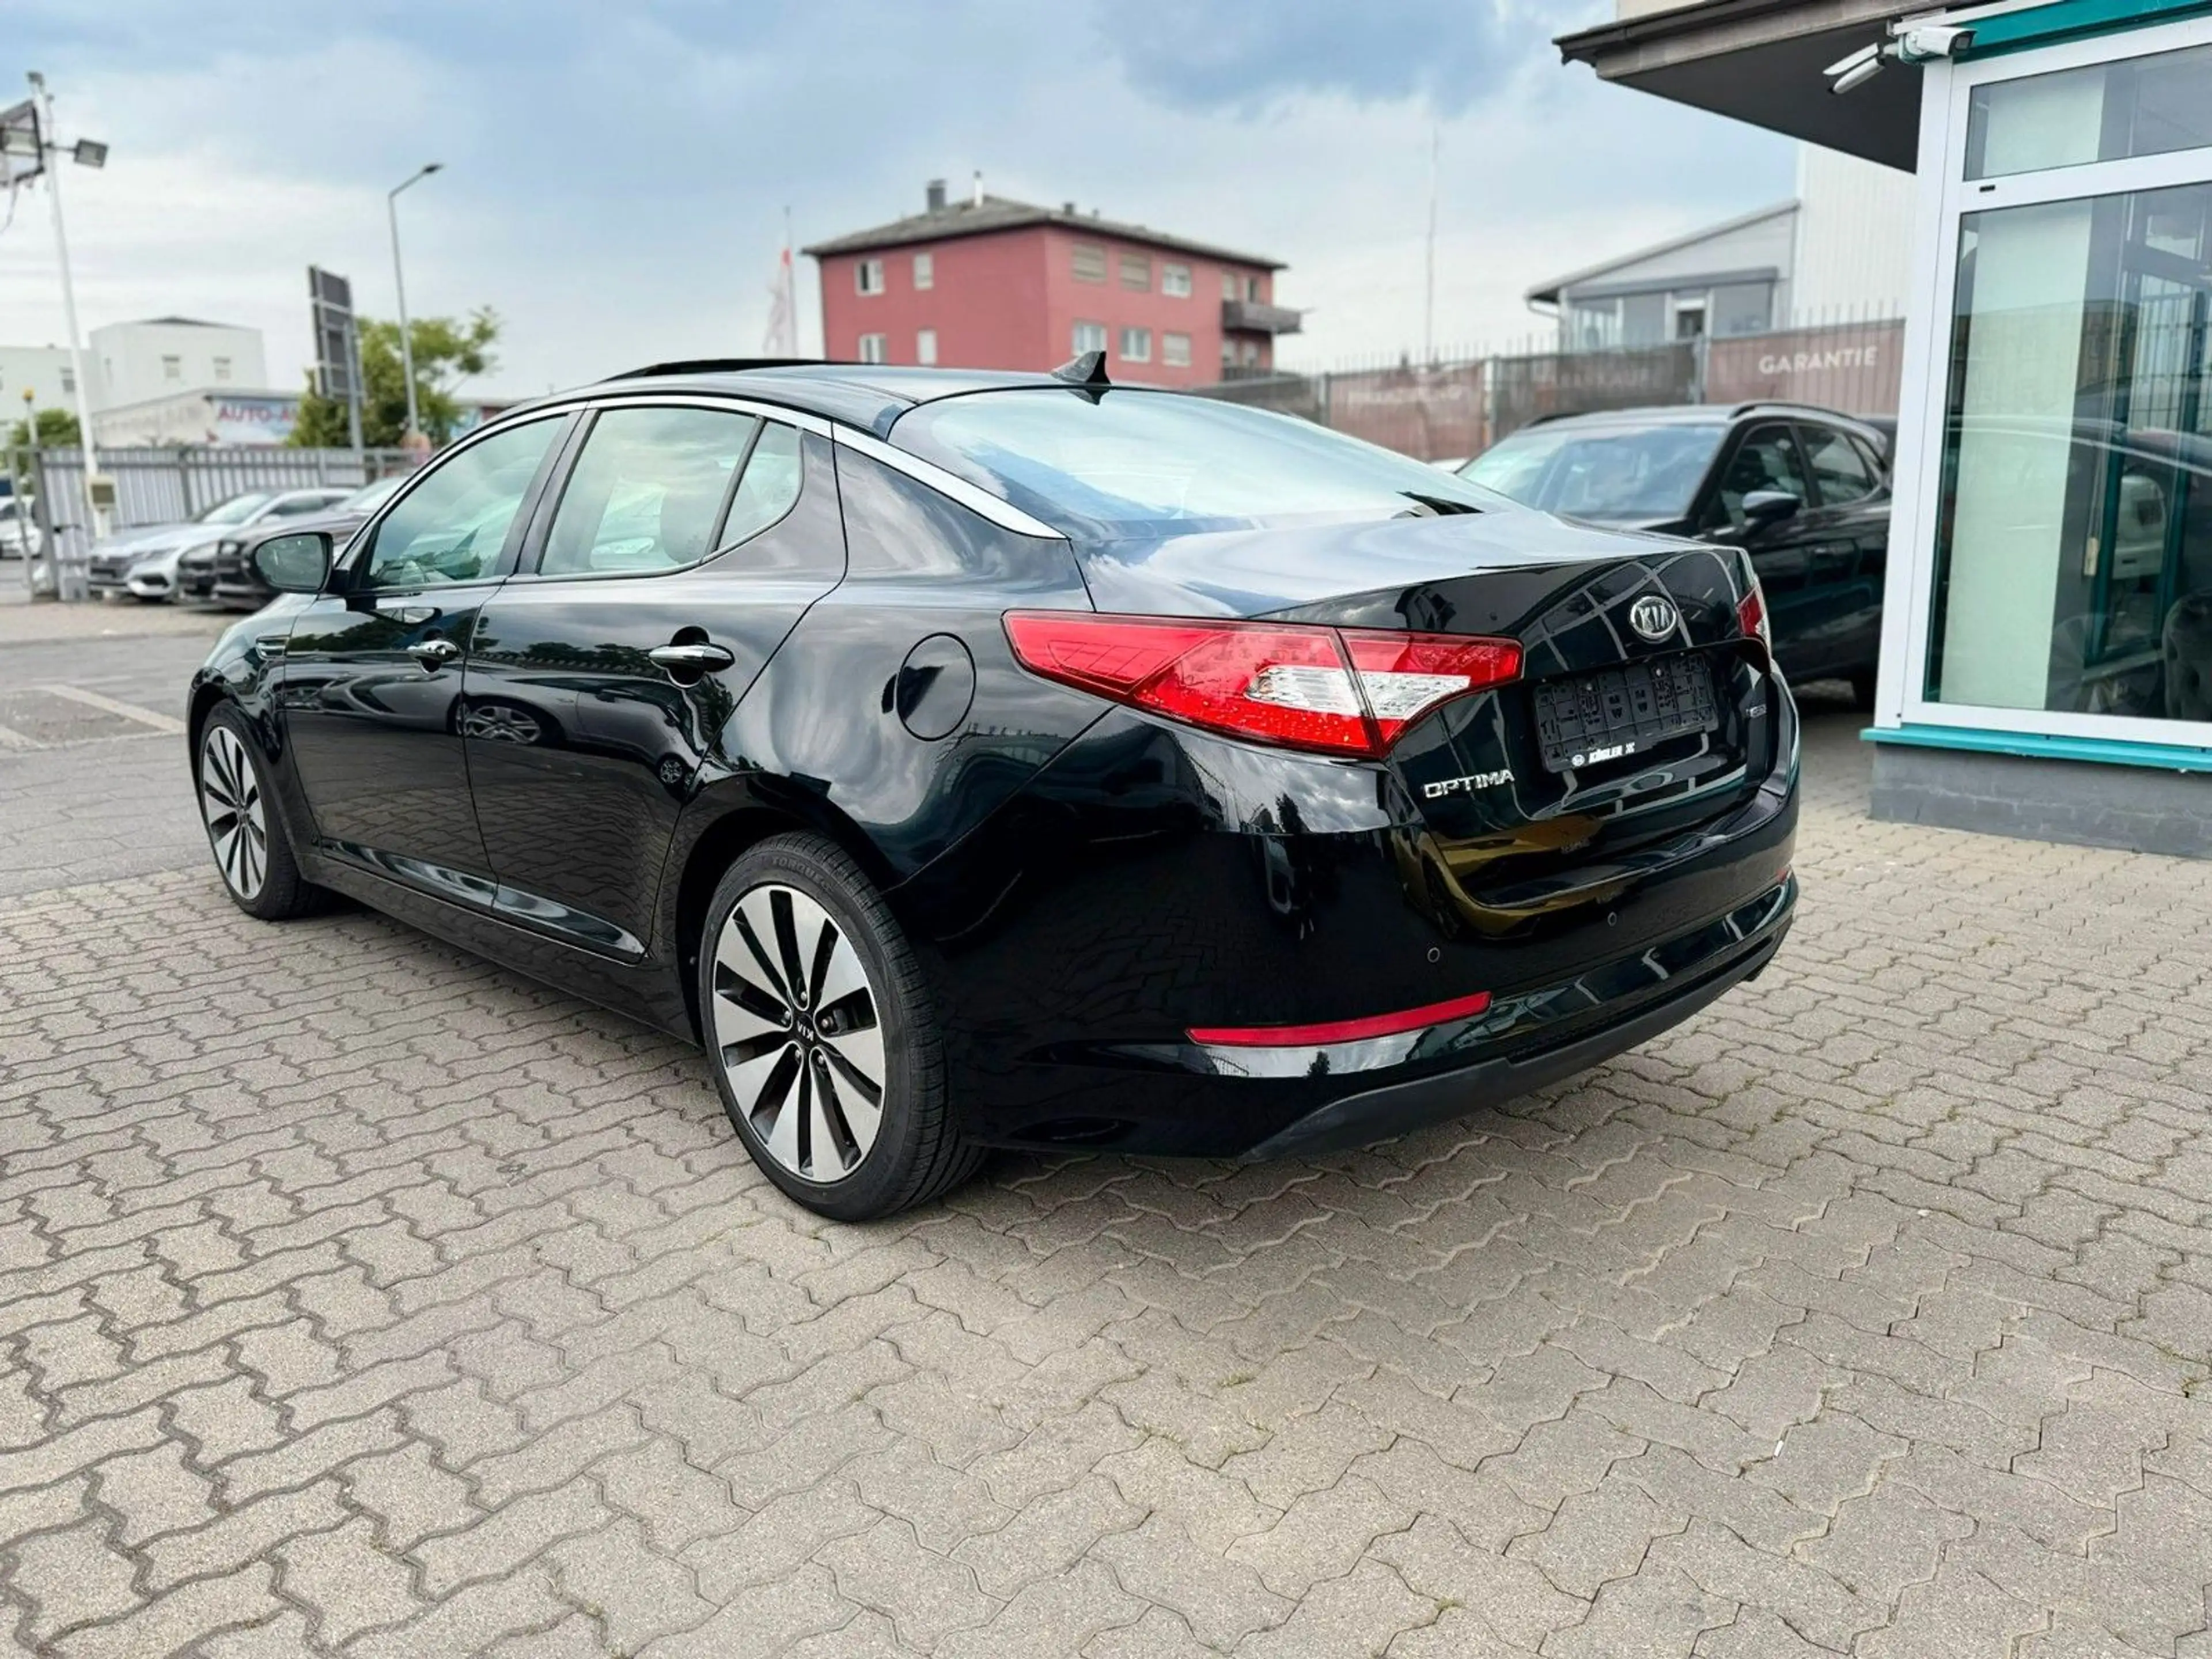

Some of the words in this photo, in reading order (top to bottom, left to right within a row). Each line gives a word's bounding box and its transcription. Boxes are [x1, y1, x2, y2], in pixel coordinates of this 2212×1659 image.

[1759, 345, 1877, 374] GARANTIE
[1638, 605, 1671, 632] KIA
[1423, 769, 1515, 798] OPTIMA
